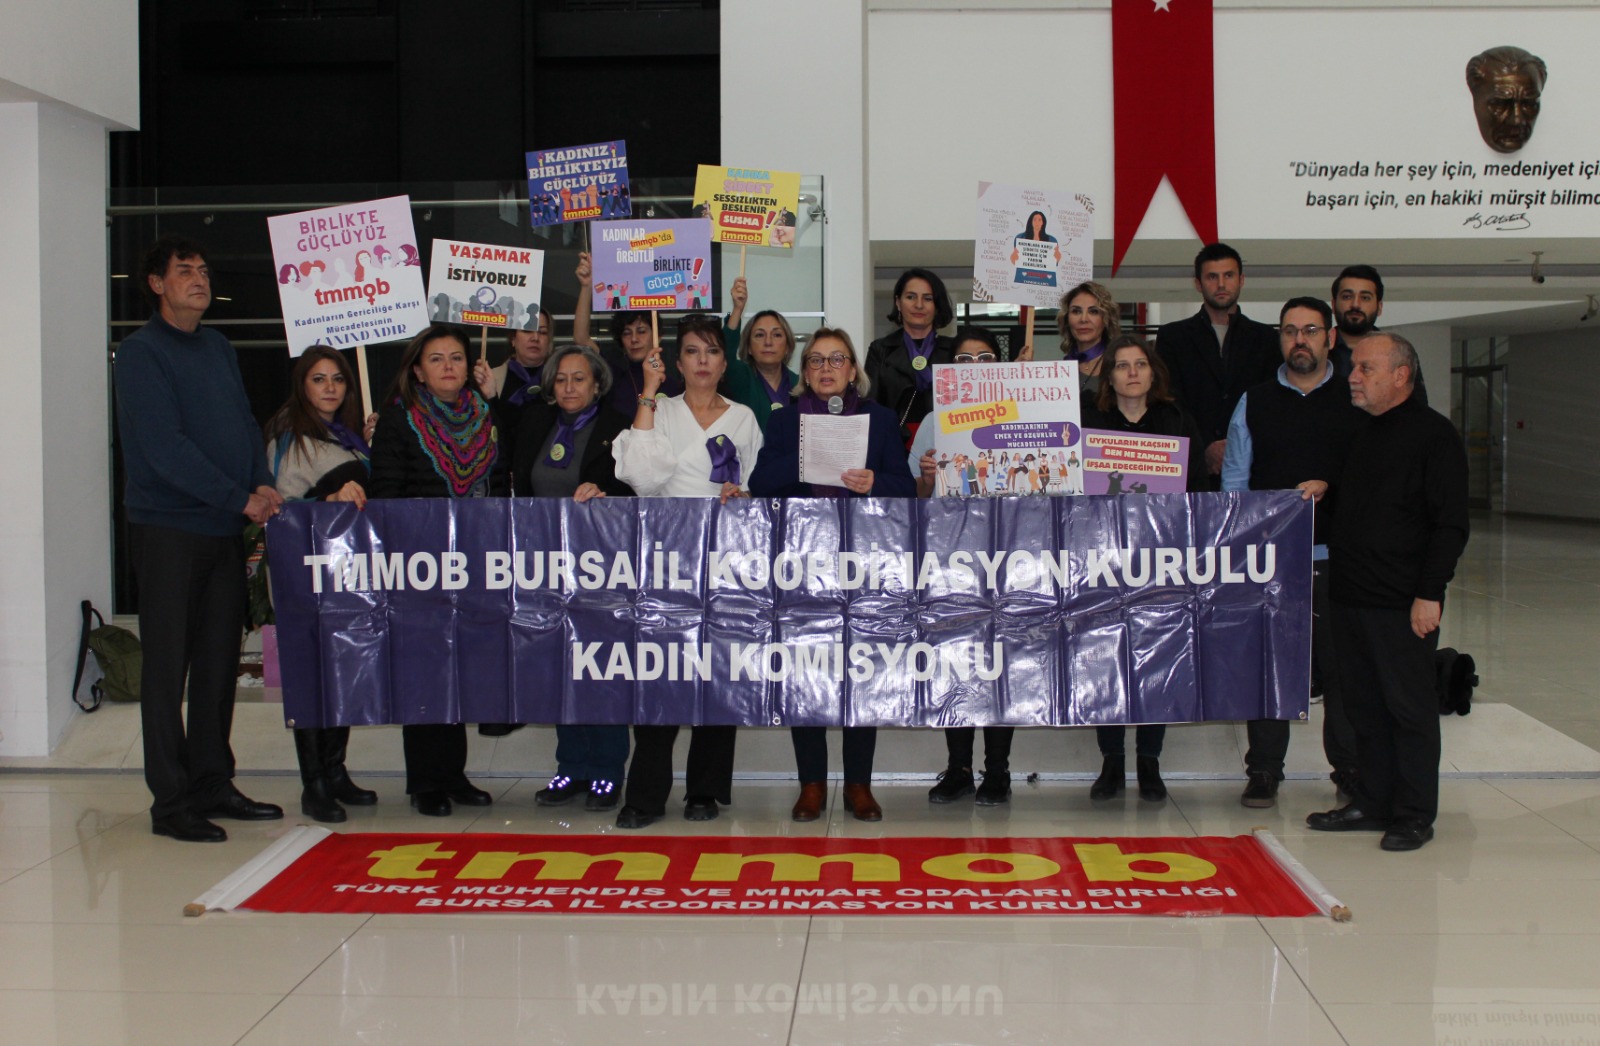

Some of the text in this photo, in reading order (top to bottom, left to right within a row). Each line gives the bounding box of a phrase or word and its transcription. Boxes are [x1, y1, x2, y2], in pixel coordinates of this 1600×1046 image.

[544, 145, 609, 163] KADINIZ
[529, 157, 627, 179] BİRLİKTEYİZ
[1374, 161, 1403, 177] her
[1407, 164, 1438, 180] şey
[1442, 161, 1477, 180] için,
[1483, 160, 1575, 180] medeniyet
[1579, 160, 1600, 180] içi
[1306, 190, 1359, 210] başarı
[1364, 190, 1399, 209] için,
[1405, 193, 1425, 206] en
[1430, 189, 1483, 206] hakiki
[1490, 189, 1546, 210] mürşit
[563, 206, 602, 219] tmmob
[723, 215, 760, 227] SUSMA
[299, 209, 379, 235] BİRLİKTE
[297, 225, 387, 252] GÜÇLÜYÜZ
[602, 228, 646, 242] KADINLAR
[722, 231, 762, 242] tmmob
[616, 247, 654, 263] ÖRGÜTLÜ
[653, 256, 692, 271] BİRLİKTE
[447, 263, 527, 287] İSTİYORUZ
[647, 273, 682, 290] GÜÇLÜ
[314, 278, 390, 306] tmmob
[630, 296, 675, 306] tmmob
[294, 300, 420, 327] Kadınların Gericiliğe Karşı
[463, 312, 506, 323] tmmob
[326, 317, 393, 334] Mücadelesinin
[960, 362, 1070, 380] CUMHURİYETİN
[1005, 387, 1071, 402] YILINDA
[947, 403, 1007, 425] tmmob
[1089, 437, 1139, 446] UYKULARIN
[1140, 440, 1170, 448] KAÇSIN
[1104, 448, 1167, 461] BEN NE ZAMAN
[1113, 462, 1154, 472] EDECEĞİM
[304, 541, 1277, 593] TMMOB BURSA İL KOORDİNASYON KURULU
[572, 632, 1003, 682] KADIN KOMİSYONU
[367, 841, 1218, 883] tmmob
[332, 883, 1238, 897] TÜRK MÜHENDİS VE MİMAR ODALARI BİRLİĞİ
[415, 898, 1142, 910] BURSA İL KOORDİNASYON KURULU
